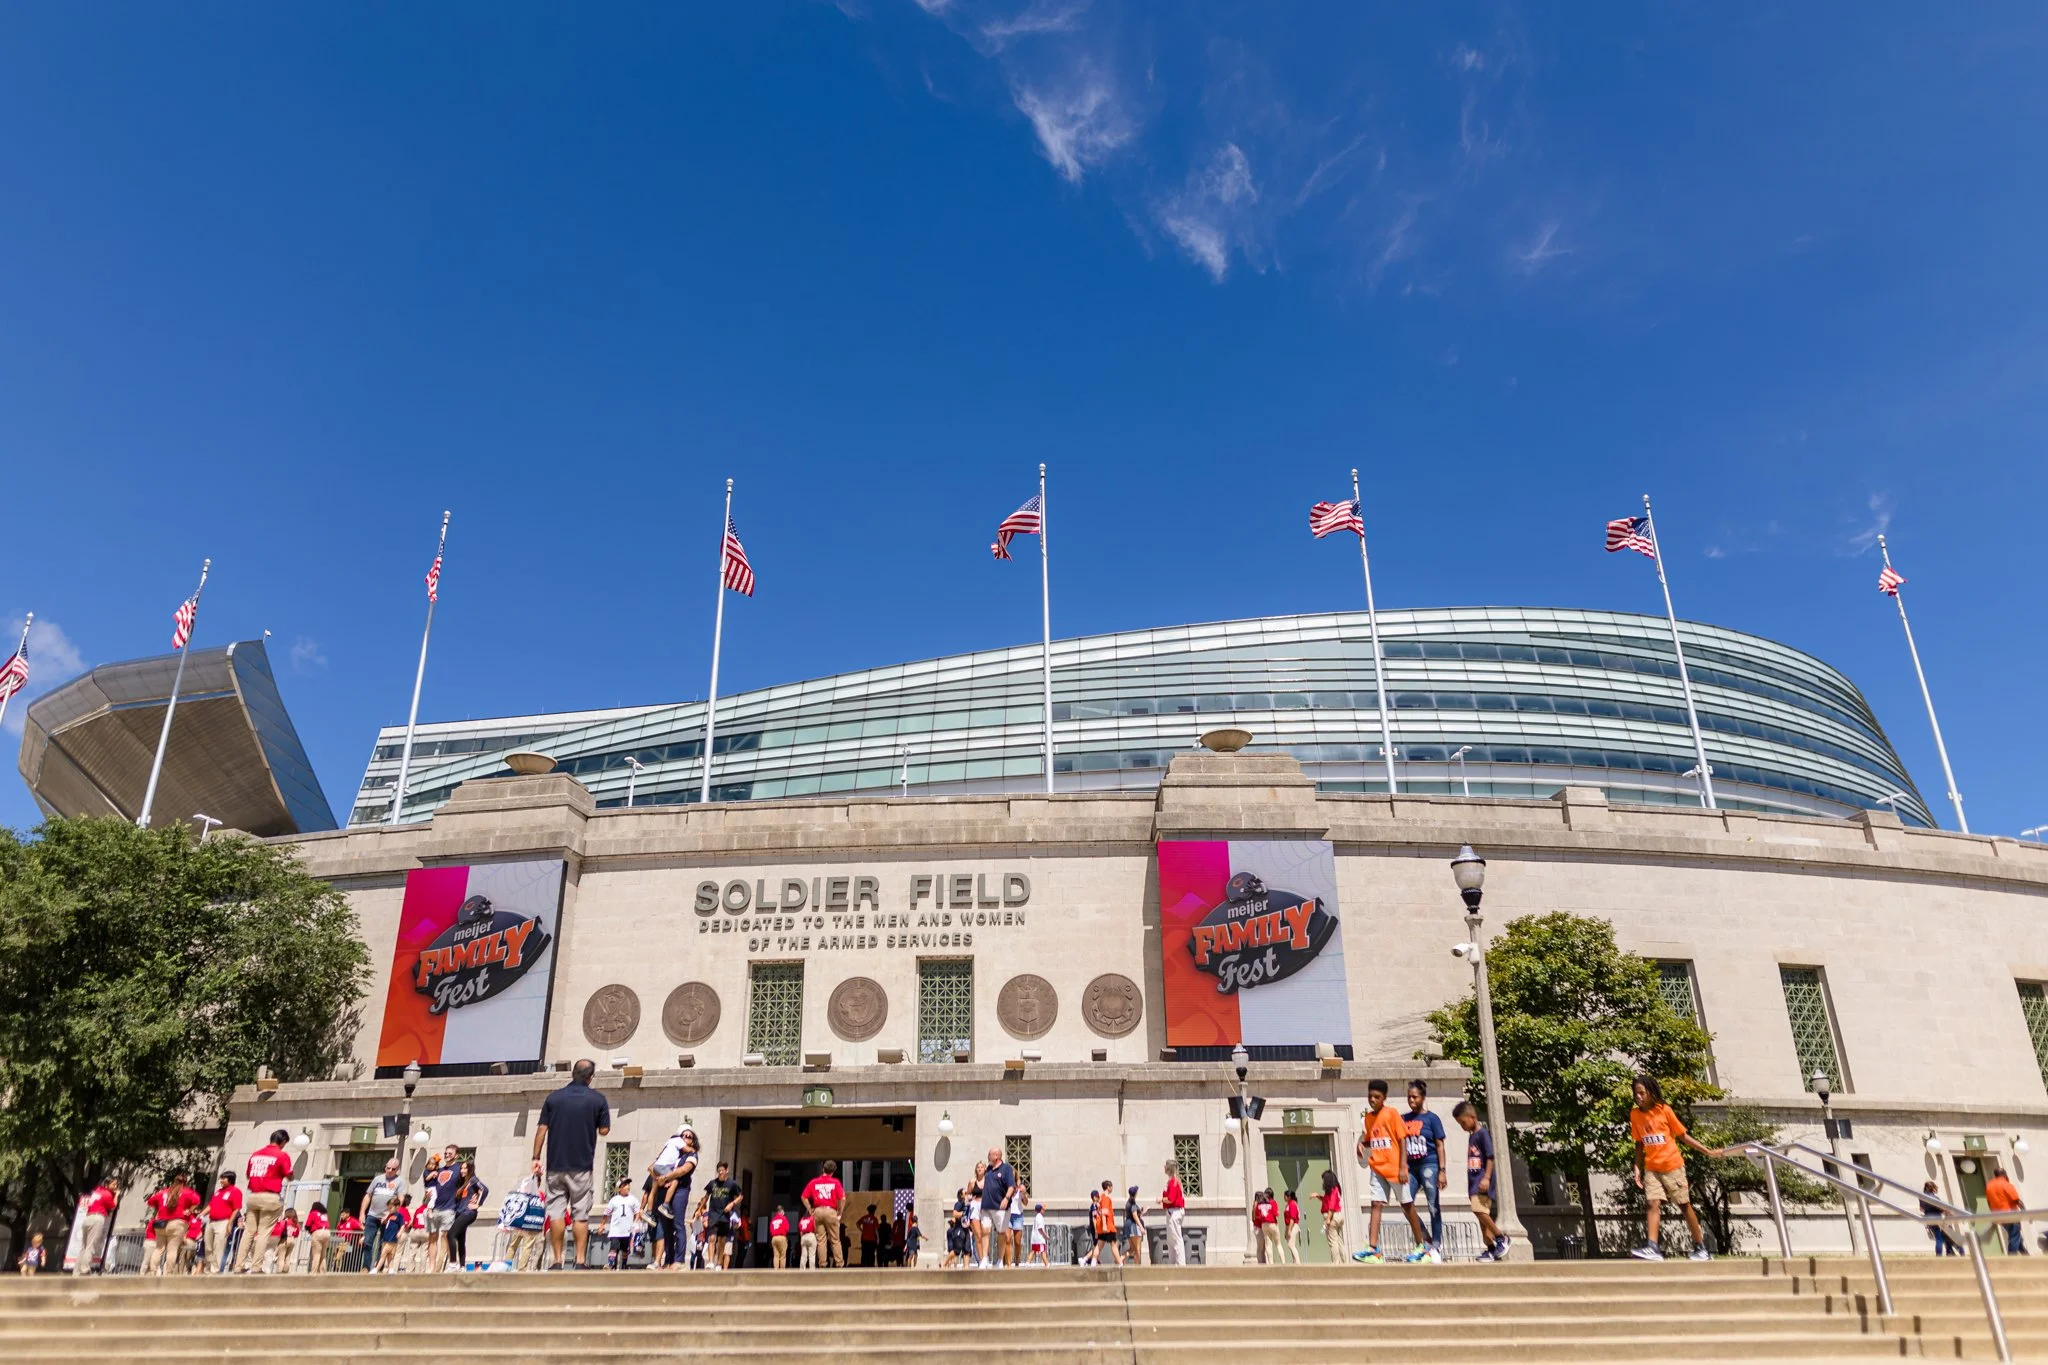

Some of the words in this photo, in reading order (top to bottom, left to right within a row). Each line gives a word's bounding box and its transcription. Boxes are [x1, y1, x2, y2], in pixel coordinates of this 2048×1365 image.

[695, 876, 879, 914] SOLDIER
[910, 872, 1031, 908] FIELD
[1228, 899, 1269, 918] meijer
[454, 920, 493, 942] meijer
[699, 917, 795, 933] DEDICATED
[803, 916, 825, 929] TO
[833, 915, 865, 929] THE
[874, 914, 909, 928] MEN
[918, 913, 952, 927] AND
[961, 912, 1025, 926] WOMEN
[1192, 899, 1316, 965] FAMILY
[749, 937, 770, 952] OF
[778, 936, 810, 951] THE
[818, 934, 878, 950] ARMED
[887, 933, 973, 949] SERVICES
[417, 918, 536, 988] FAMILY
[1217, 947, 1280, 993] Fest
[429, 967, 490, 1013] Fest
[820, 1092, 827, 1104] 0
[1290, 1111, 1297, 1123] 2
[1305, 1111, 1310, 1123] 2
[363, 1128, 368, 1140] 1
[1972, 1137, 1980, 1148] 4
[620, 1204, 627, 1217] 1
